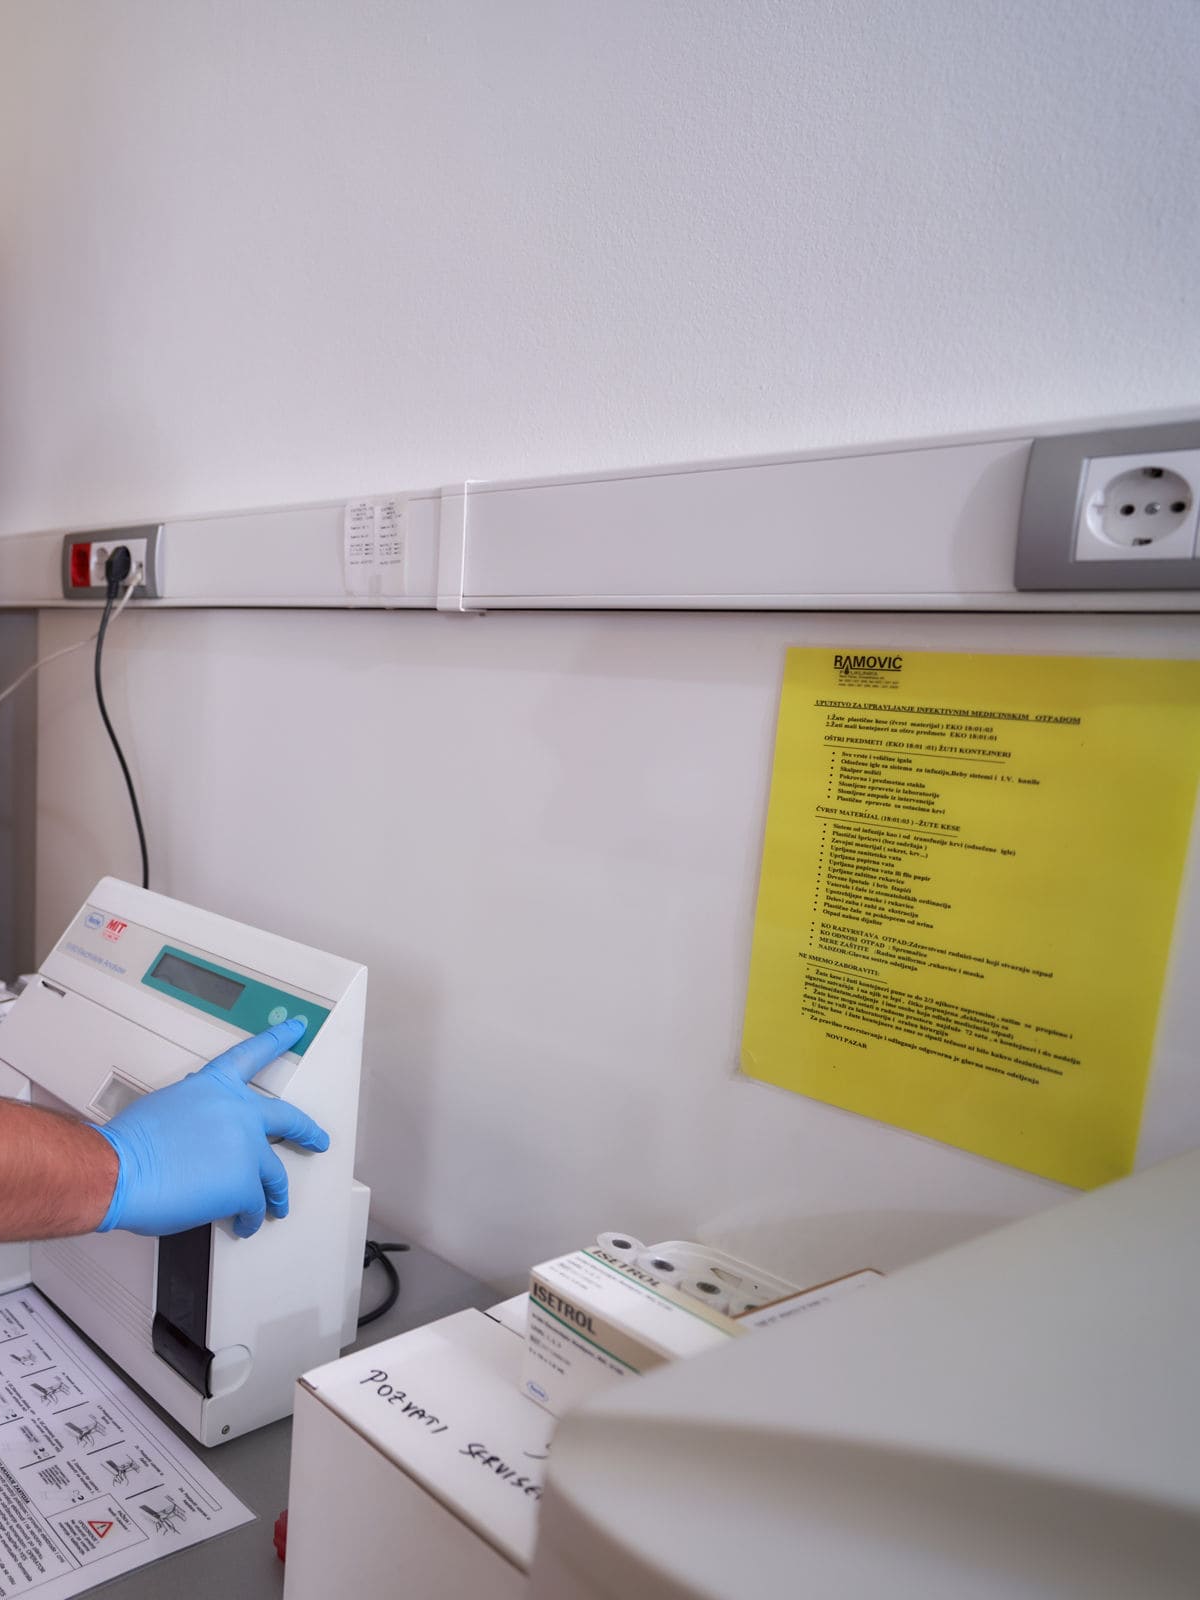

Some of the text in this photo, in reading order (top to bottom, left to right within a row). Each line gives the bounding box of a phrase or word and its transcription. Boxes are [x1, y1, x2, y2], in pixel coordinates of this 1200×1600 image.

[834, 654, 903, 670] RAMOVIĆ
[815, 700, 852, 708] UPUTSTVO
[863, 703, 914, 713] UPRAVLJANJE
[916, 707, 970, 716] INFEKTIVNIM
[971, 710, 1030, 721] MEDICINSKIM
[1035, 715, 1081, 724] OTPADOM
[824, 735, 845, 743] OŠTRI
[846, 738, 883, 747] PREDMETI
[885, 741, 905, 750] (EKO
[938, 744, 958, 753] ŽUTI
[960, 748, 1012, 758] KONTEJNERI
[816, 805, 837, 815] ČVRST
[940, 824, 961, 832] KESE
[106, 919, 128, 934] MIT
[832, 925, 879, 940] RAZVRSTAVA
[819, 936, 839, 946] MERE
[840, 940, 869, 953] ZAŠTITE
[832, 932, 858, 943] ODNOSI
[861, 938, 885, 949] OTPAD
[809, 954, 833, 965] SMEMO
[826, 1032, 868, 1050] NOVI PAZAR
[592, 1250, 660, 1287] ISETROL
[533, 1282, 596, 1335] ISETROL
[360, 1369, 448, 1434] POZVATI
